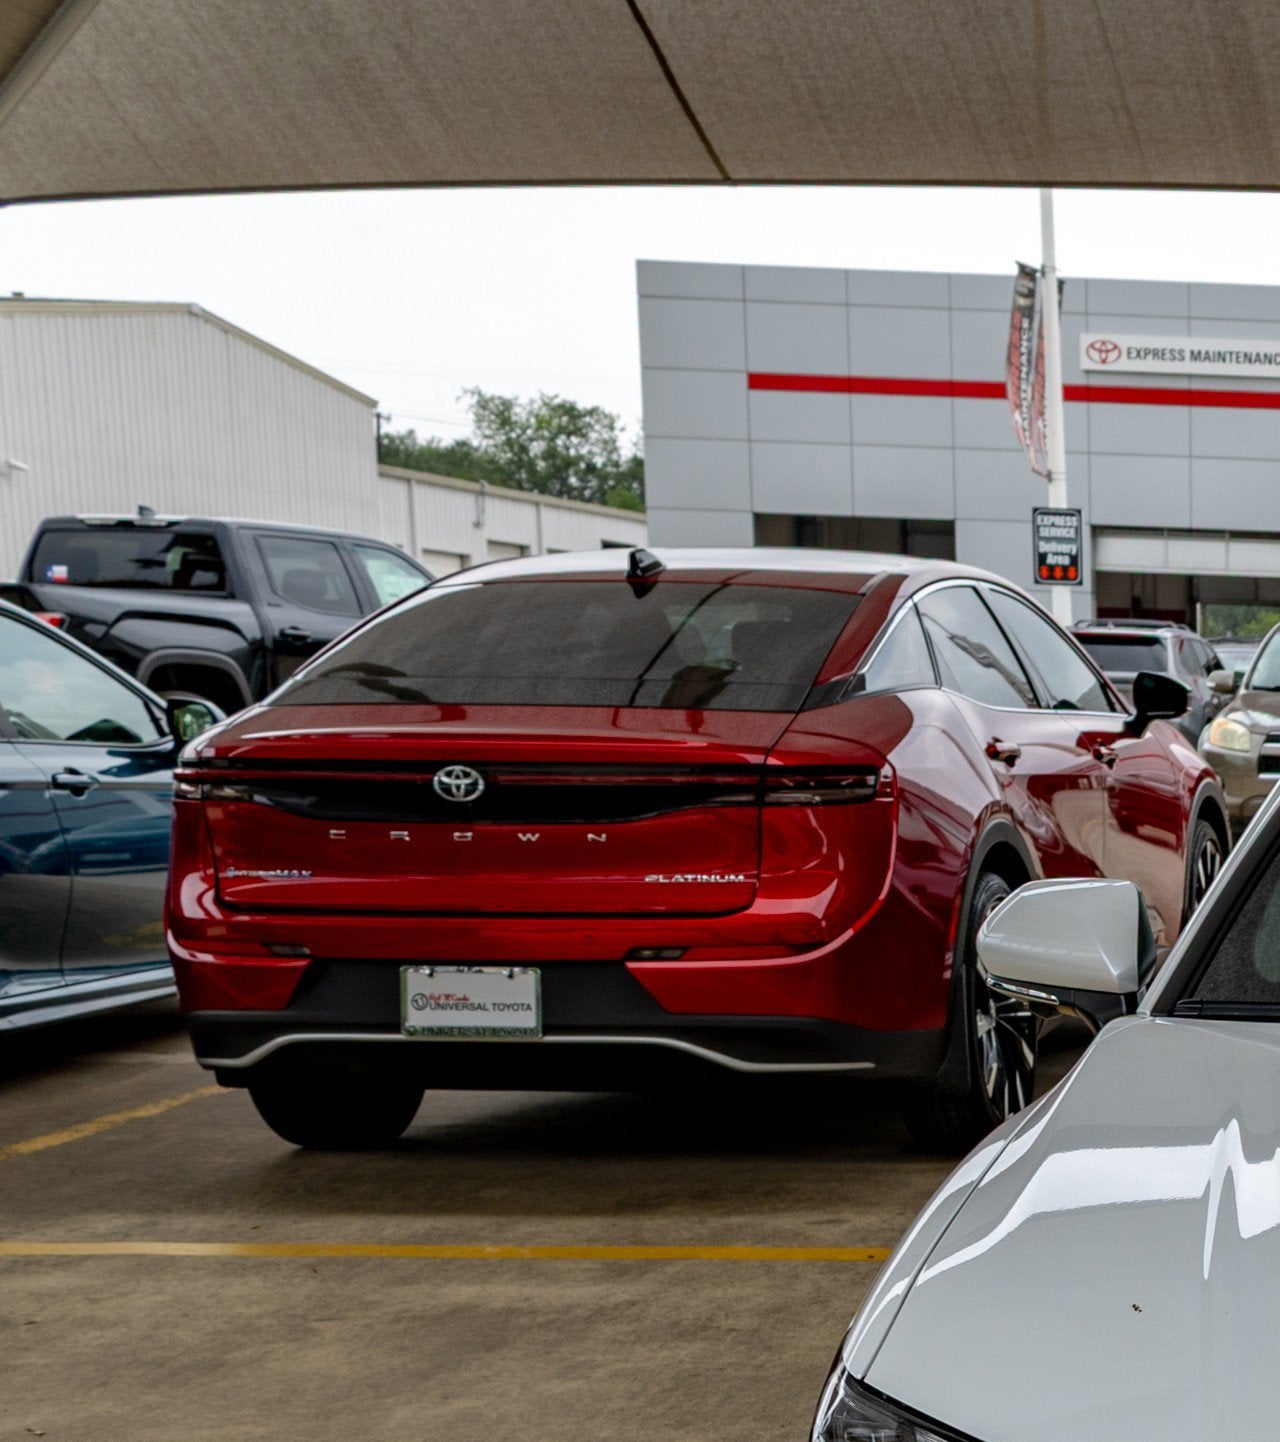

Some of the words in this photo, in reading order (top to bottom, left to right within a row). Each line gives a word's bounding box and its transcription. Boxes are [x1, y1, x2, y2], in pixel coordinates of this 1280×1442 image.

[1126, 346, 1186, 362] EXPRESS
[1019, 316, 1031, 449] MAINTENANCE
[1036, 514, 1078, 527] EXPRESS
[1038, 526, 1077, 538] SERVICE
[1038, 541, 1077, 556] Delivery
[1046, 553, 1071, 566] Area
[328, 829, 607, 842] CROWN
[644, 873, 745, 883] PLATINUM
[428, 1002, 489, 1012] UNIVERSAL
[492, 1002, 533, 1012] TOYOTA
